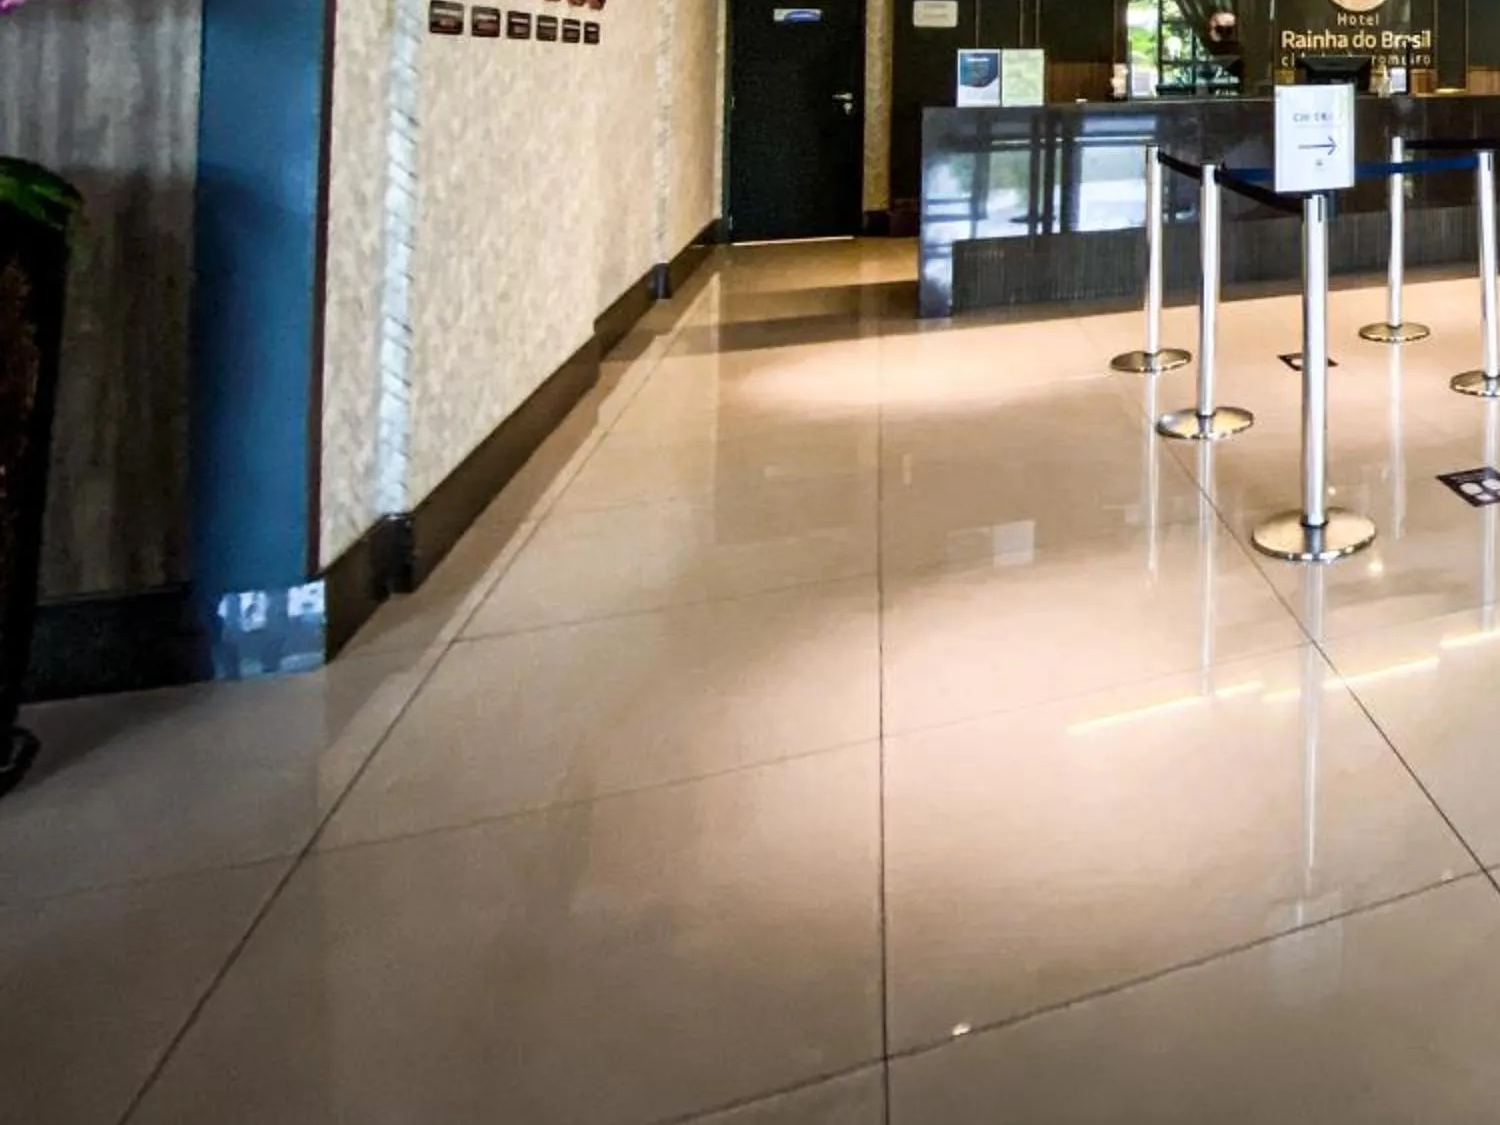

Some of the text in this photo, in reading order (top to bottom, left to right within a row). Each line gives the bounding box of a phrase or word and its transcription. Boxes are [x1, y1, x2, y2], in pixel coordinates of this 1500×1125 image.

[1337, 12, 1380, 26] Hotel
[1281, 28, 1349, 49] Rainha
[1352, 28, 1377, 49] do
